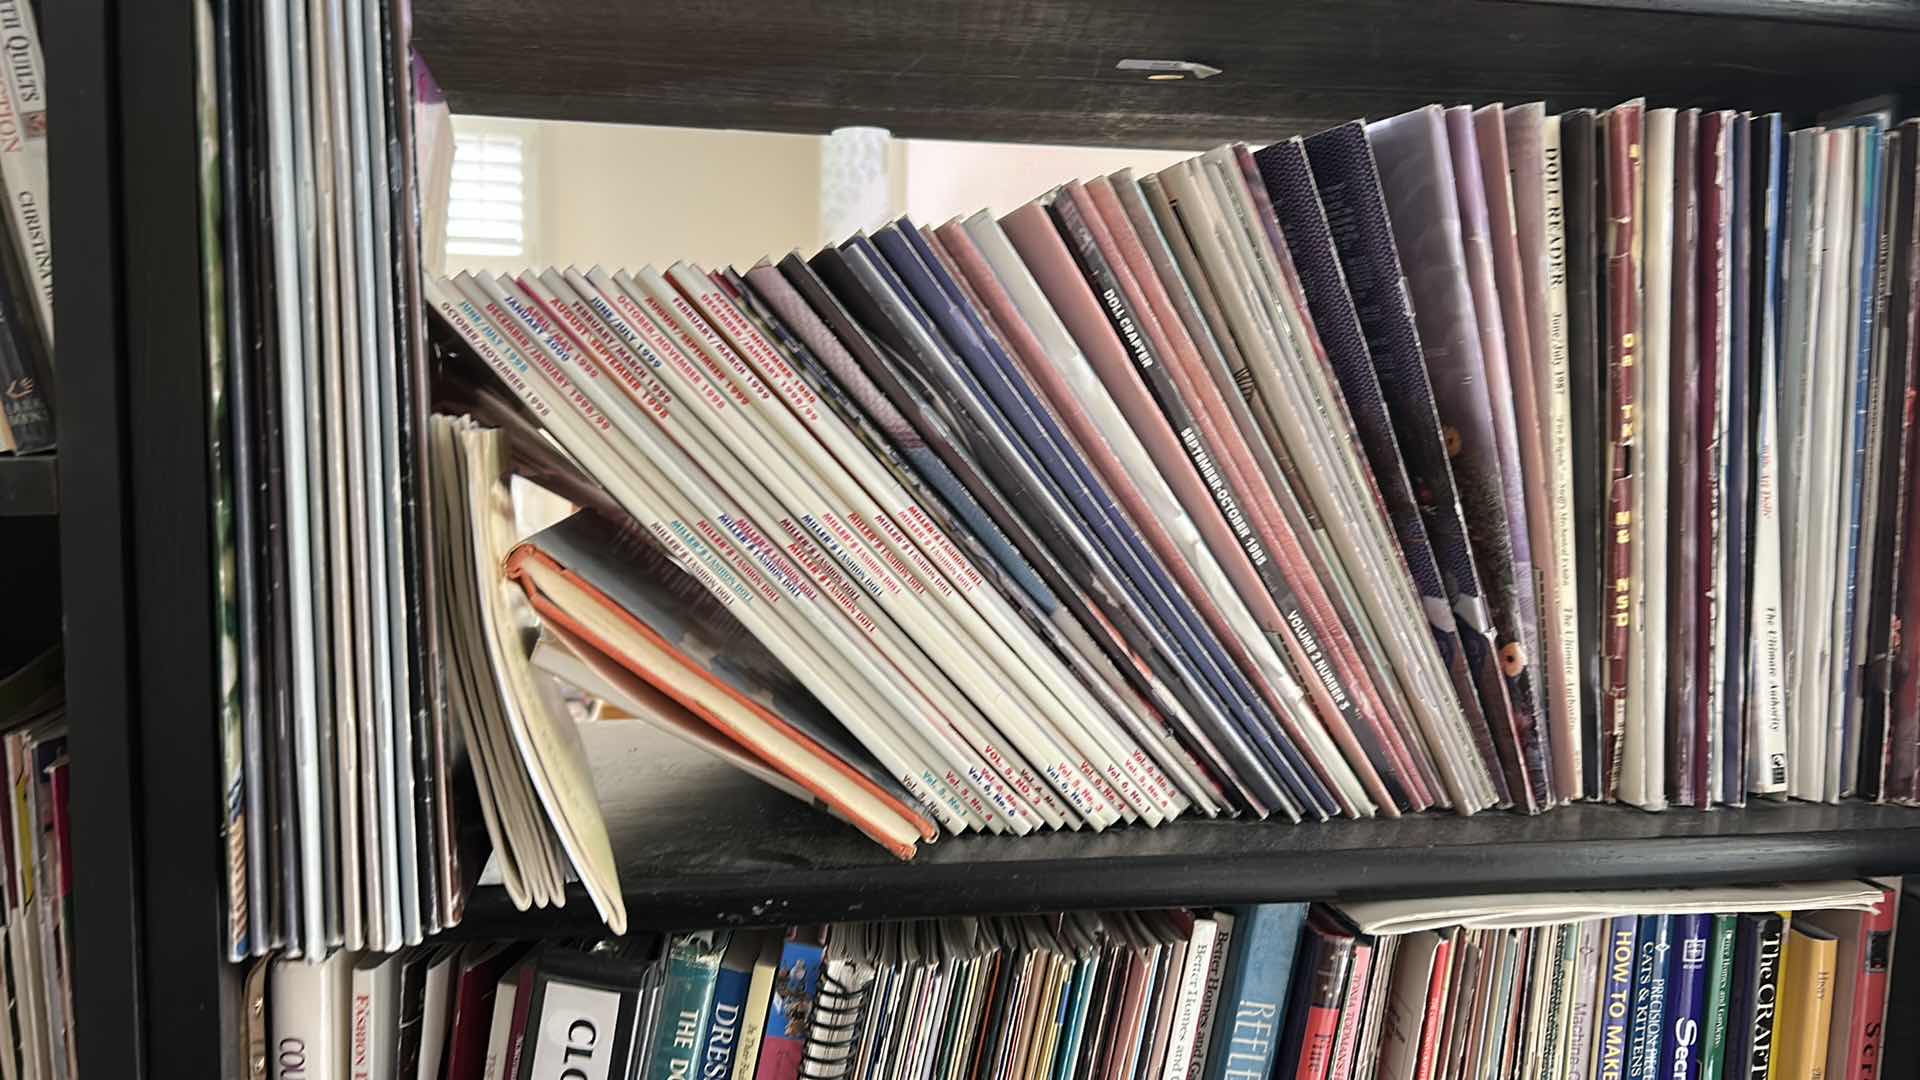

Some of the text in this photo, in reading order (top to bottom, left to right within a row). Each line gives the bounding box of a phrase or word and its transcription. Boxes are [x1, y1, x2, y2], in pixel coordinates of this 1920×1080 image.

[6, 35, 40, 102] QUILTS
[19, 191, 52, 282] CHRISTINA
[1544, 147, 1565, 287] DOLL READER
[459, 300, 530, 373] JUNE/JULY 1998
[484, 301, 571, 389] DECEMBER/JANUARY
[504, 295, 570, 362] JANUARY 2000
[591, 296, 662, 369] JUNE/JULY 1999
[617, 295, 725, 408] OCTOBER/NOVEMBER 1998
[673, 297, 770, 399] FEBRUARY/MARCH 1999
[701, 293, 779, 379] DECEMBER/JANUARY
[712, 292, 793, 378] OCTOBER/NOVEMBER
[1102, 289, 1152, 368] DOLL CRAFTER
[441, 300, 549, 417] OCTOBER/NOVEMBER 1998
[572, 301, 672, 403] FEBRUARY/MARCH 1999
[1551, 312, 1566, 394] June/July 1987
[725, 380, 750, 406] 1999
[803, 513, 837, 551] MILLER'S
[823, 511, 857, 549] MILLER'S
[849, 511, 882, 548] MILLER'S
[876, 513, 908, 550] MILLER'S
[899, 510, 930, 545] MILLER'S
[908, 505, 940, 540] MILLER'S
[1287, 610, 1317, 653] VOLUME
[1563, 607, 1573, 625] The
[1311, 651, 1322, 661] 2
[1564, 630, 1575, 674] Ultimate
[1767, 606, 1780, 732] The Ultimate Authority
[1315, 660, 1343, 701] NUMBER
[944, 770, 962, 789] Vol.
[967, 766, 985, 785] Vol.
[992, 793, 1009, 810] No.
[983, 744, 1033, 797] VOL. NO.
[1044, 764, 1062, 782] Vol.
[1069, 791, 1086, 807] No.
[1078, 760, 1097, 779] Vol.
[1105, 763, 1123, 782] Vol.
[1129, 789, 1145, 806] No.
[1190, 945, 1207, 987] Better
[1211, 931, 1229, 976] Better
[1720, 958, 1732, 989] Homes
[1760, 932, 1781, 979] The
[1179, 991, 1198, 1041] Homes
[1200, 978, 1219, 1028] Homes
[1602, 931, 1633, 1080] HOW TO MAKE
[1631, 942, 1654, 1077] CATS & KITTENS
[1718, 990, 1728, 1007] and
[355, 995, 369, 1065] FASHION
[674, 1009, 699, 1049] THE
[704, 1002, 740, 1080] DRES
[1714, 1008, 1728, 1045] Gardens
[1172, 1045, 1184, 1072] and
